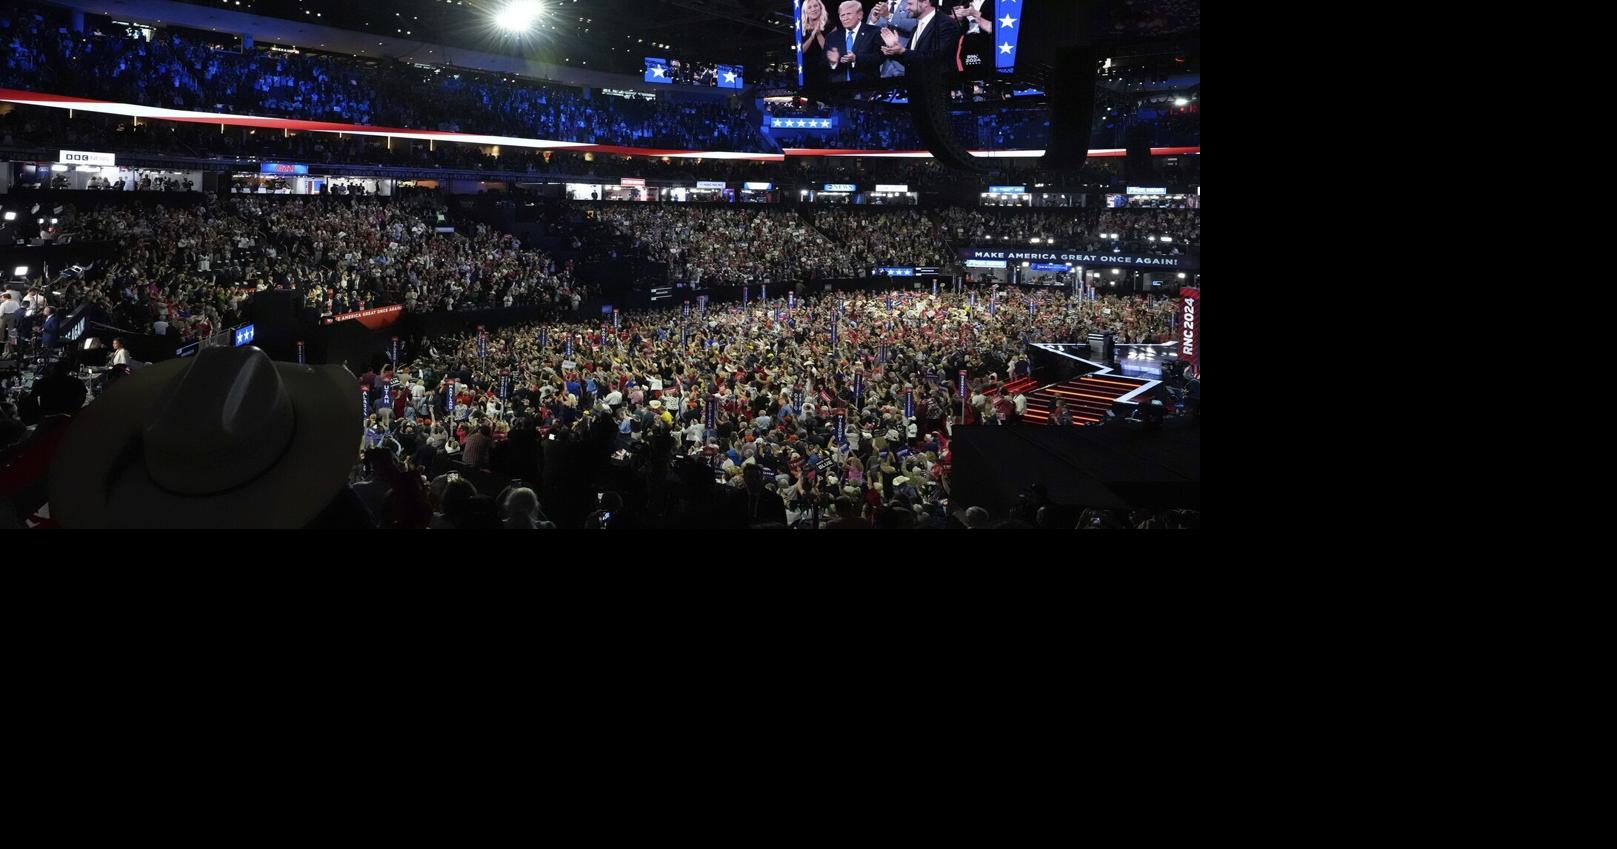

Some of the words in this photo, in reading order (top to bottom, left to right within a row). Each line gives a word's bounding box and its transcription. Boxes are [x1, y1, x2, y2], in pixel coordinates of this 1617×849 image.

[1008, 252, 1057, 261] AMERICA
[1060, 254, 1097, 262] GREAT
[1100, 256, 1132, 264] ONCE
[1135, 257, 1178, 266] AGAIN!
[341, 312, 362, 321] AMERICA
[817, 460, 833, 470] BLUE
